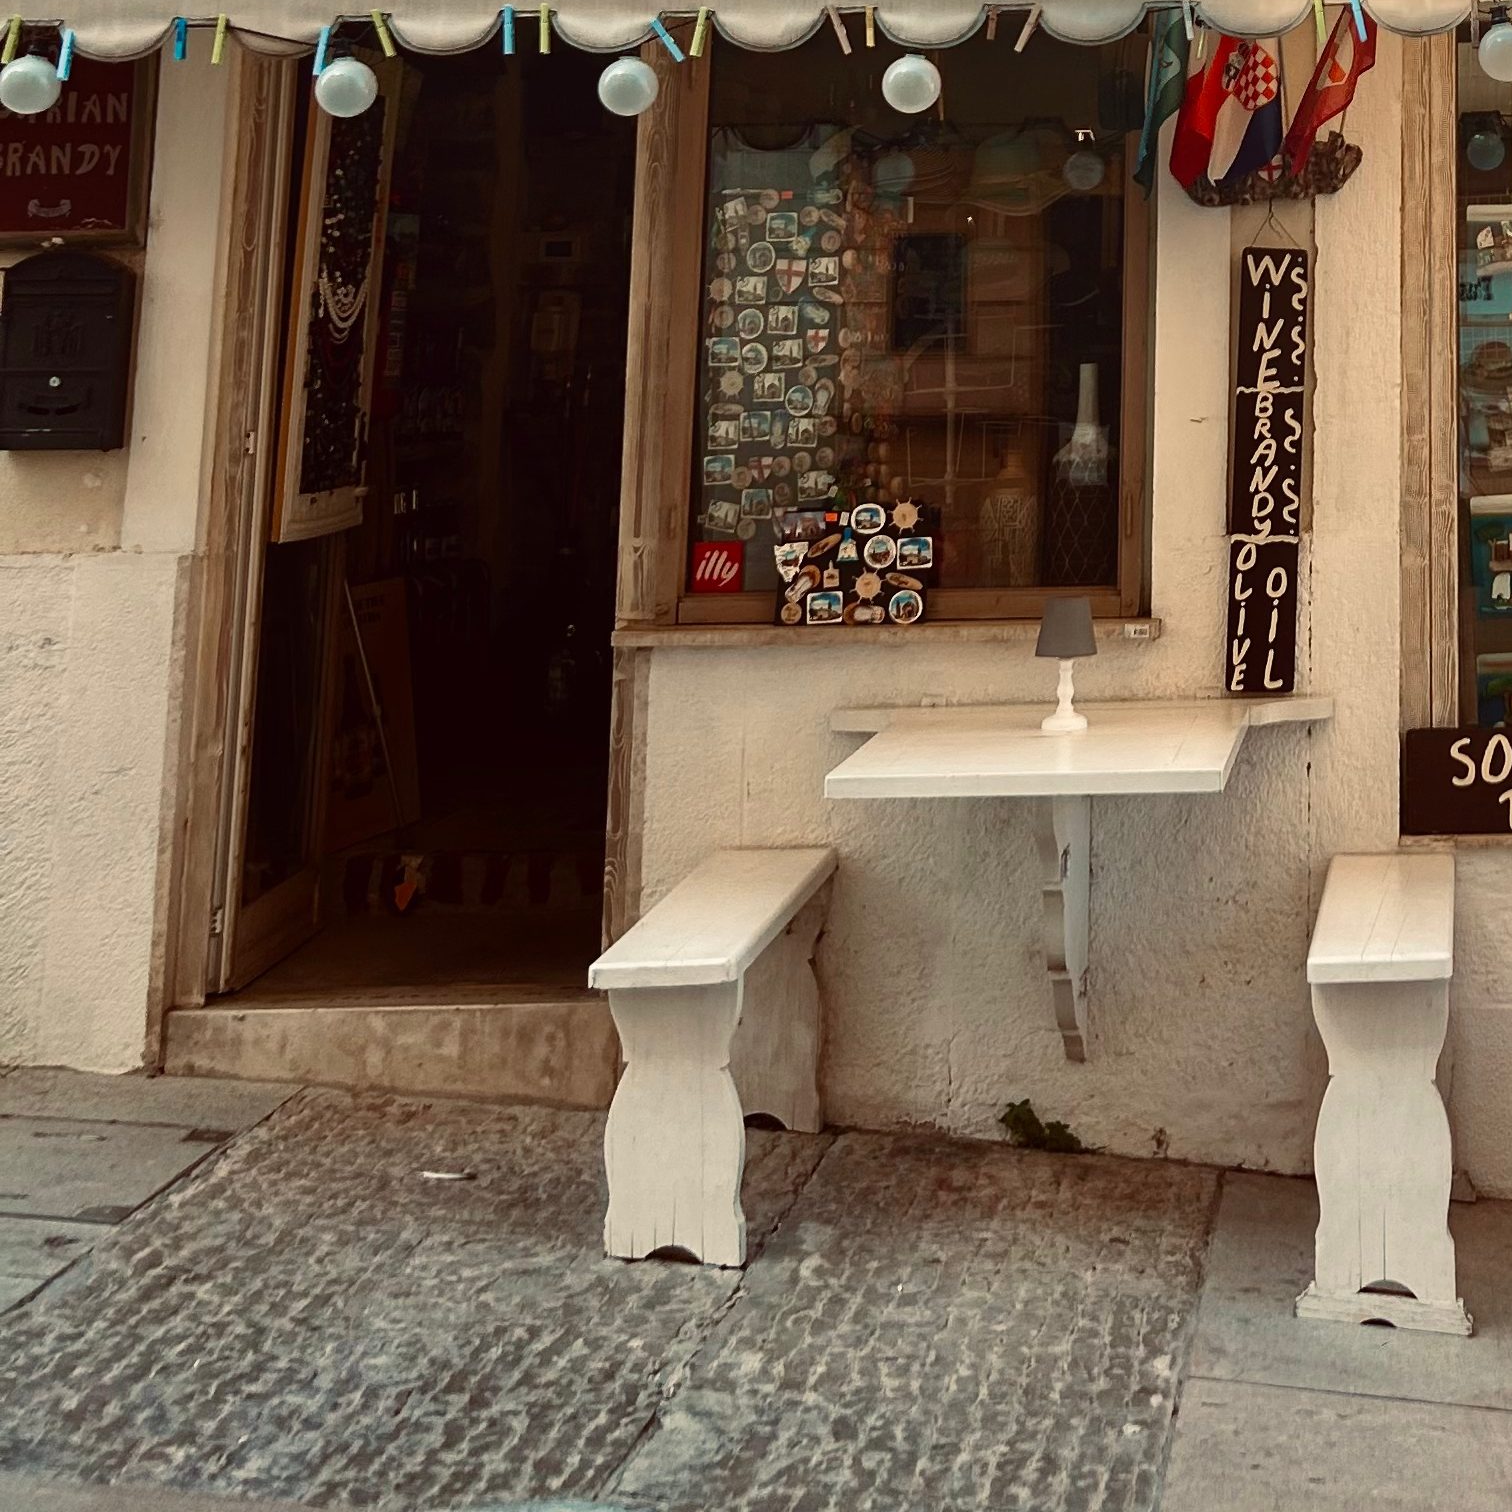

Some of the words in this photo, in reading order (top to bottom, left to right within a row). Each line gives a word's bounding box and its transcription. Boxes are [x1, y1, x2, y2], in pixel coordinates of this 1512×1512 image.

[0, 140, 122, 177] RANDY
[1247, 252, 1291, 392] WINE
[1249, 390, 1279, 541] BRANDY
[695, 549, 740, 587] illy
